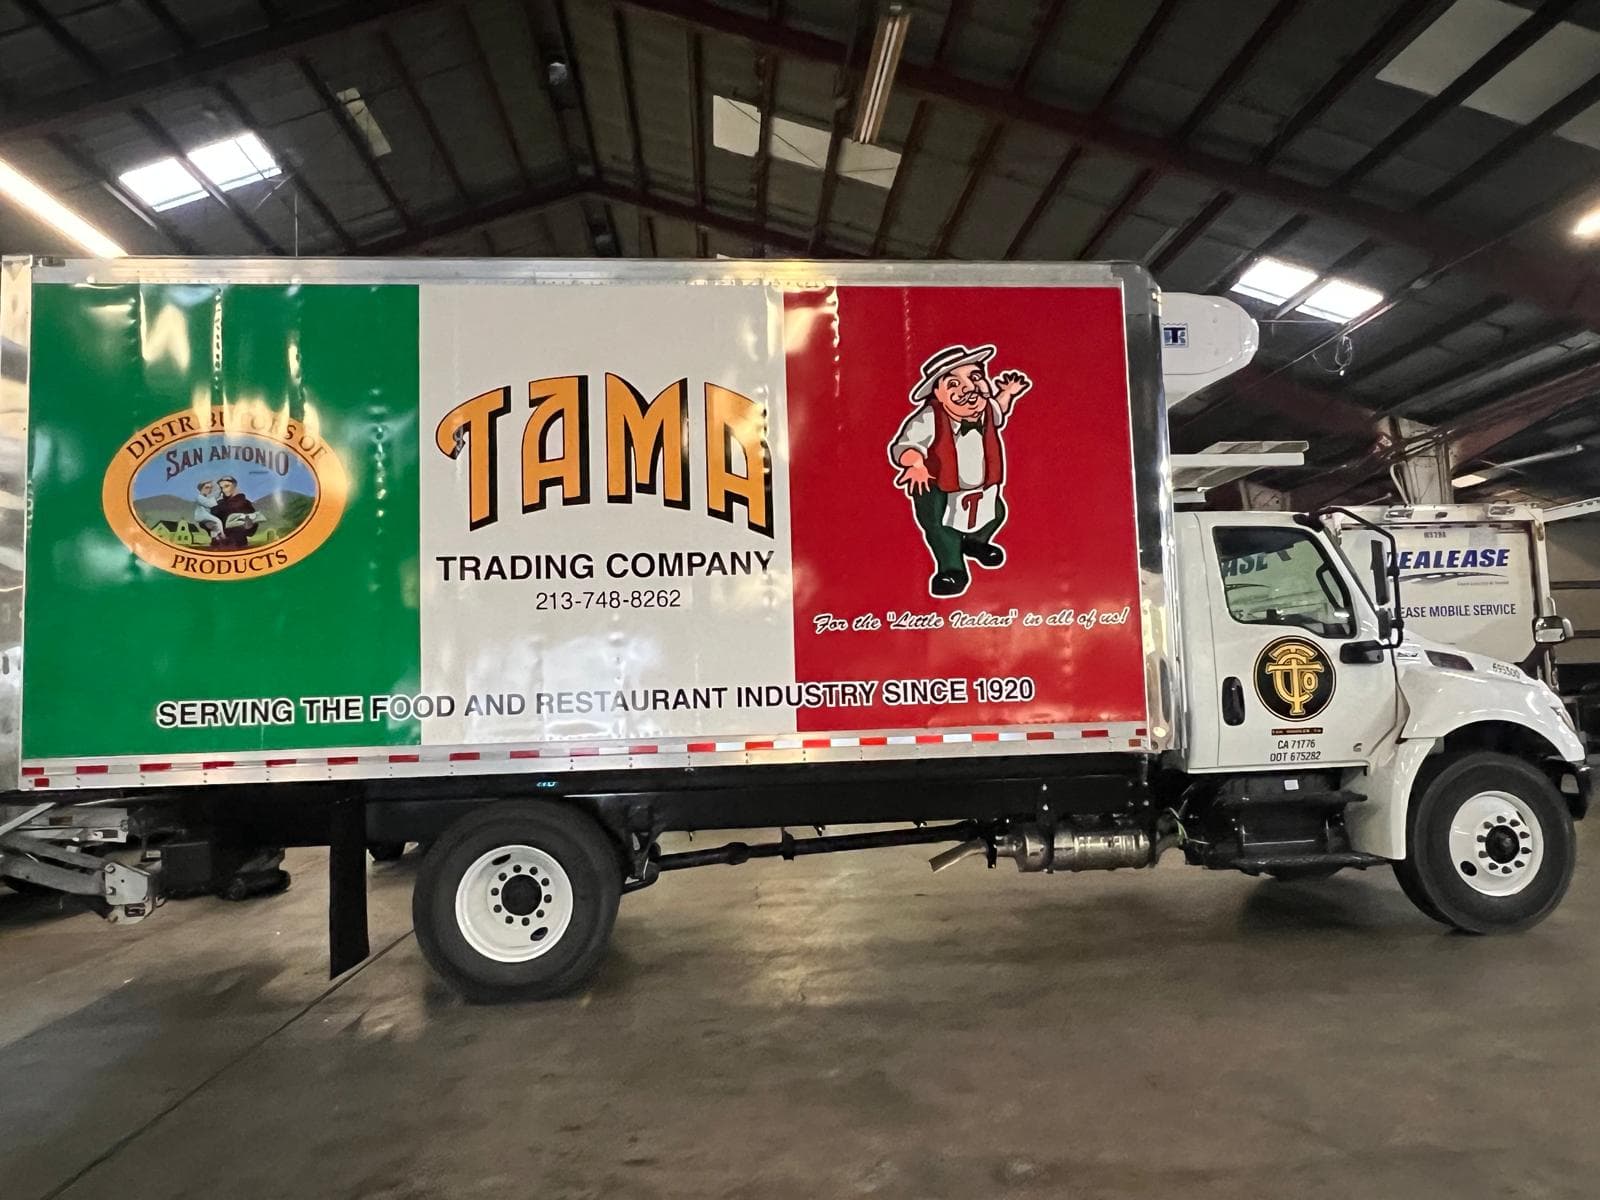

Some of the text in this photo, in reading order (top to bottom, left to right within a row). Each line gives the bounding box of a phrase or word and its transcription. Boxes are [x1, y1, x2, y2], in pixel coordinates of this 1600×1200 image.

[166, 445, 290, 481] SAN ANTONIO
[435, 372, 774, 539] TAMA
[170, 549, 288, 574] PRODUCTS
[436, 550, 775, 581] TRADING COMPANY
[535, 589, 681, 610] 213-748-8262
[1429, 605, 1470, 617] MOBILE
[1473, 603, 1517, 616] SERVICE
[813, 606, 1130, 634] For the "Little Italian" in all of us!
[157, 677, 1035, 728] SERVING THE FOOD AND RESTAURANT INDUSTRY SINCE 1920
[1277, 739, 1316, 749] CA 71776
